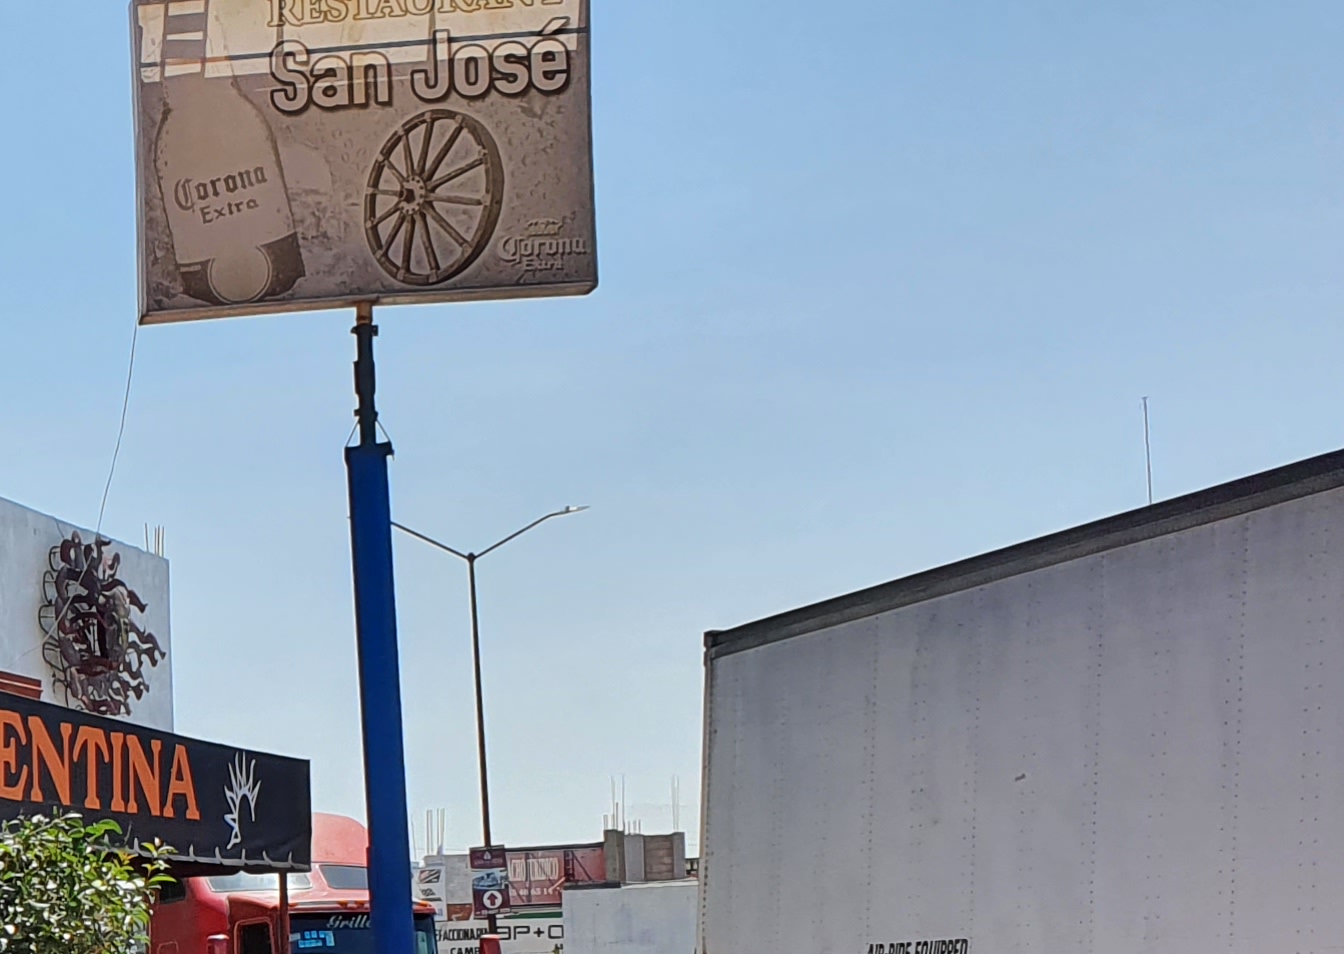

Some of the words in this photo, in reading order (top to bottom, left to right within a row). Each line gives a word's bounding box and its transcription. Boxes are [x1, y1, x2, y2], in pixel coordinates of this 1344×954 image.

[270, 40, 392, 114] San
[411, 17, 570, 100] José
[174, 165, 268, 211] Corona
[199, 198, 259, 224] Extra
[498, 237, 587, 264] Corona
